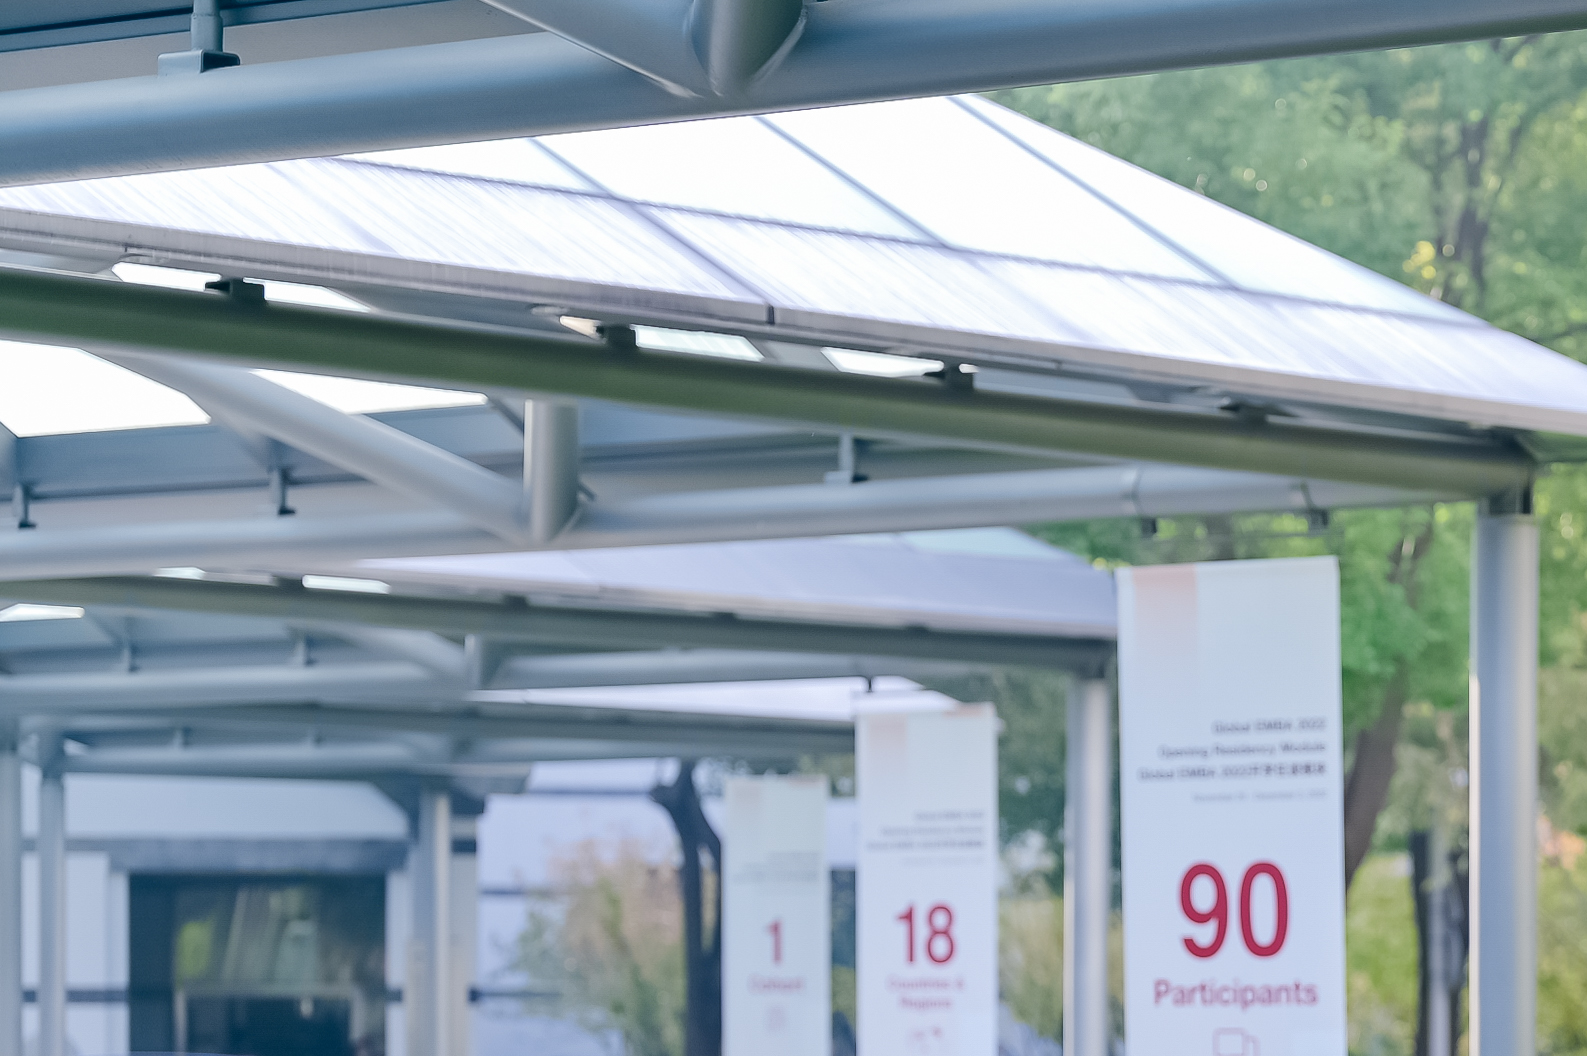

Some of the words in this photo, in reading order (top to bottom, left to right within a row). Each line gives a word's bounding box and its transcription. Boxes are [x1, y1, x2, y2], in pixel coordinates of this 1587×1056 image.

[898, 904, 955, 965] 18
[1180, 863, 1288, 958] 90
[767, 919, 783, 966] 1
[1154, 978, 1319, 1012] Participants
